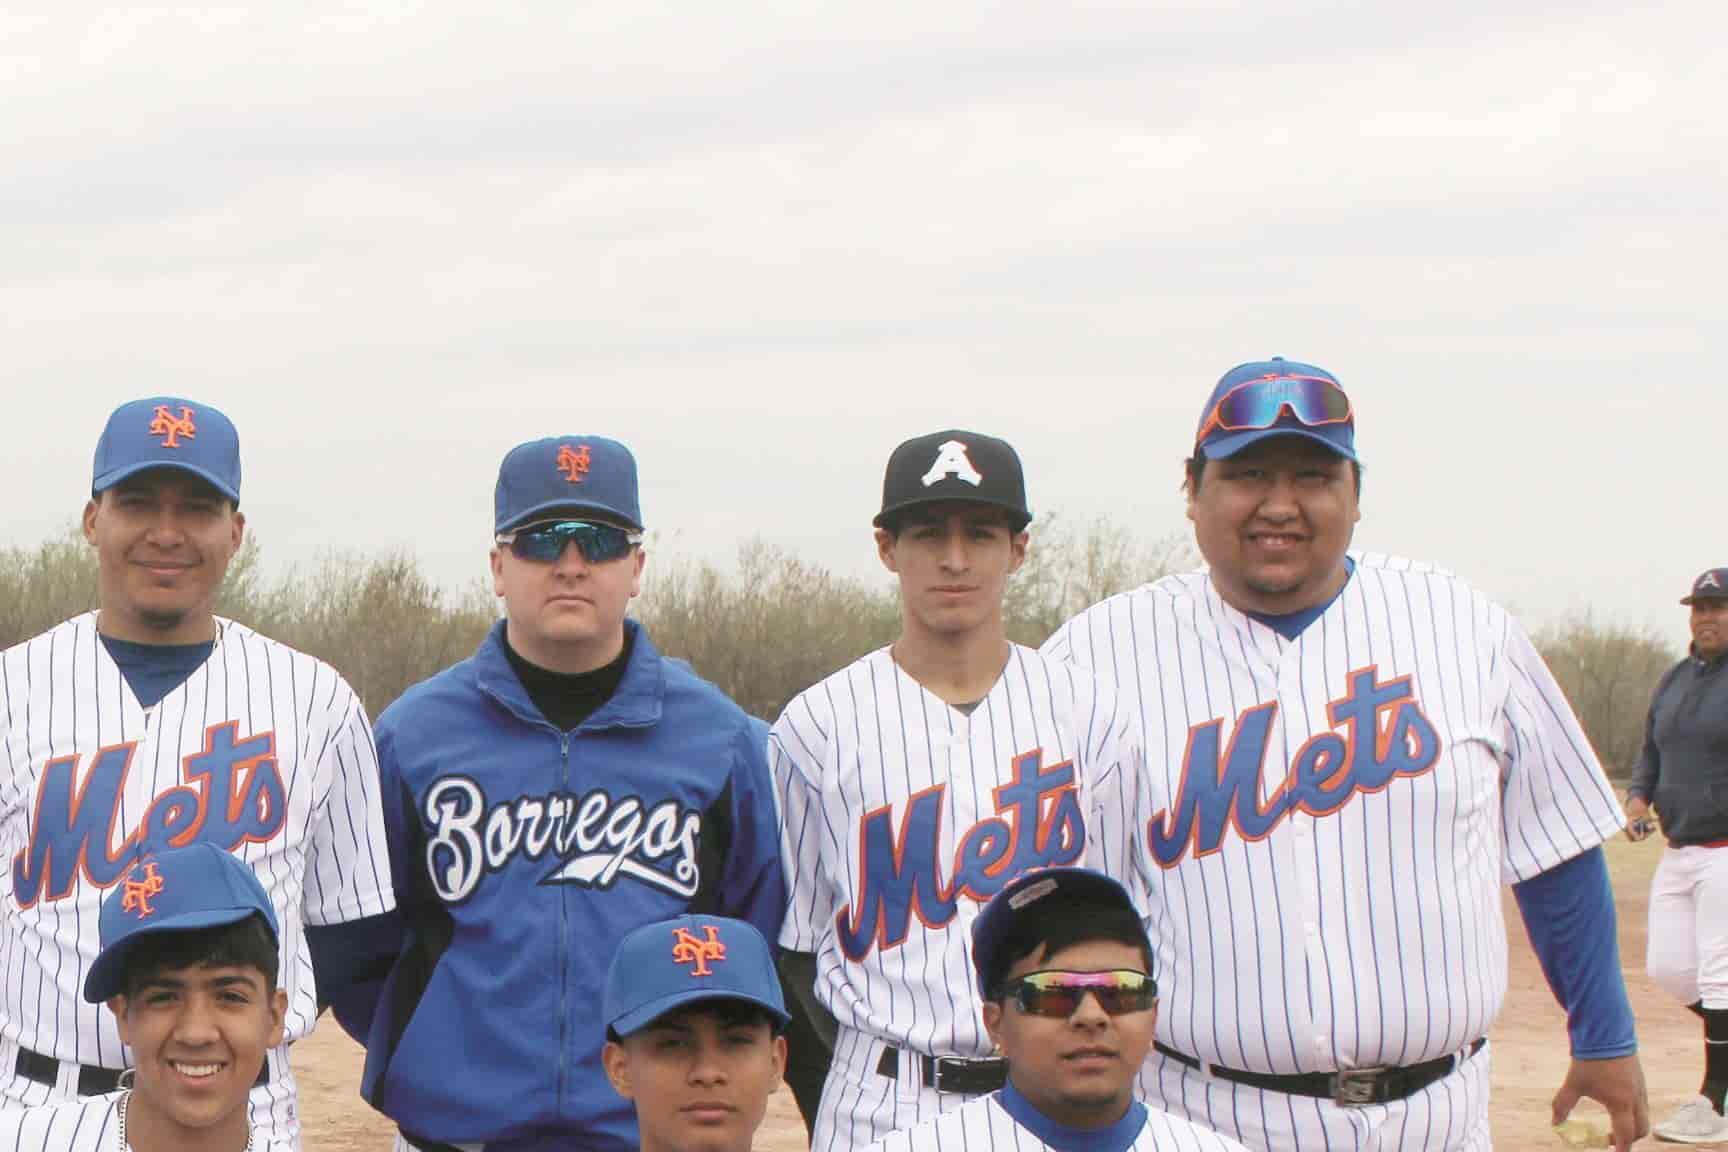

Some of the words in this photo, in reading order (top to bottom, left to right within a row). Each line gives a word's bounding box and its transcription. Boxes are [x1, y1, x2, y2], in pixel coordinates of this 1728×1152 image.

[921, 439, 983, 487] A
[13, 720, 288, 910] Mets
[425, 775, 701, 902] Borregos
[836, 748, 1086, 963] Mets
[1147, 664, 1441, 870] Mets
